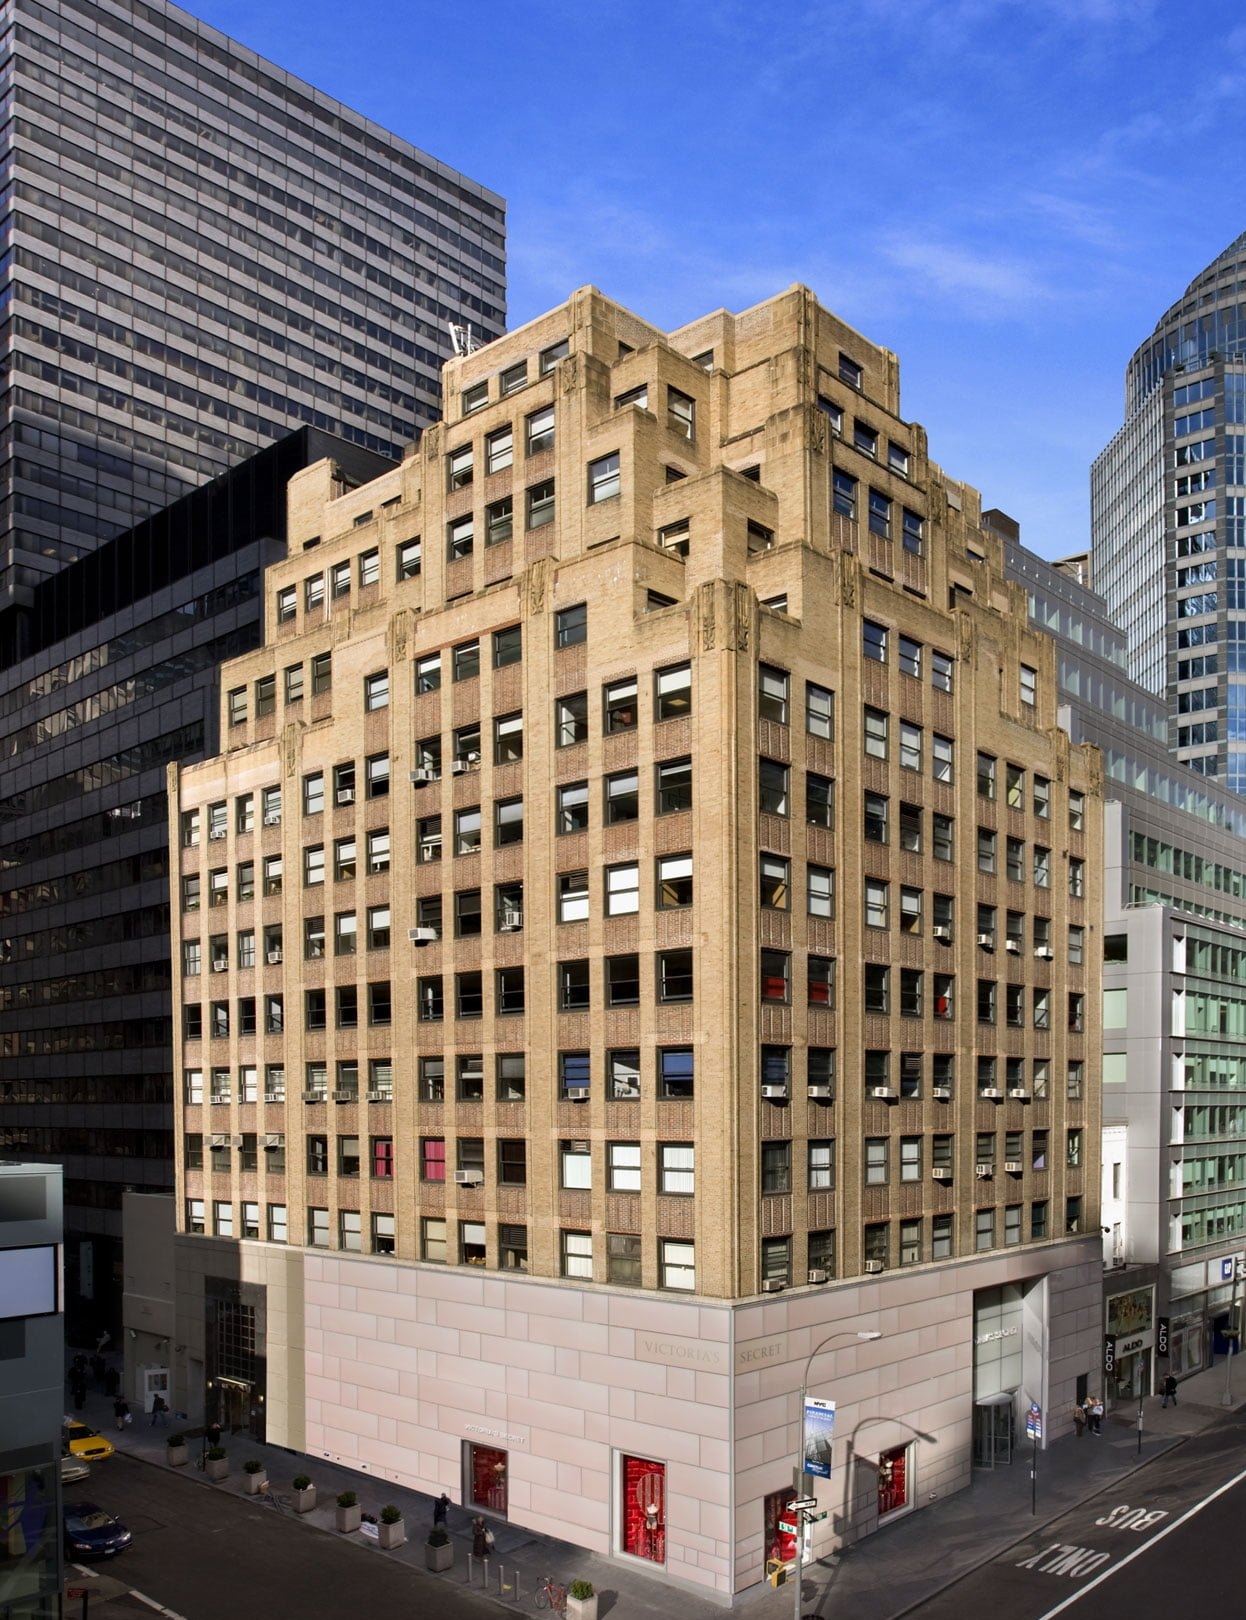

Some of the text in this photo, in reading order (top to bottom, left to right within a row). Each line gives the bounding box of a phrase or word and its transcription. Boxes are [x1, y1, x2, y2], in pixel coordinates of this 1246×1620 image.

[1122, 1339, 1143, 1353] ALDO
[1159, 1323, 1167, 1352] ALDO
[643, 1340, 782, 1364] VICTORIA'S SECRET
[1105, 1341, 1113, 1372] ALDO
[1095, 1504, 1169, 1532] BUS
[1015, 1543, 1111, 1578] ONLY
